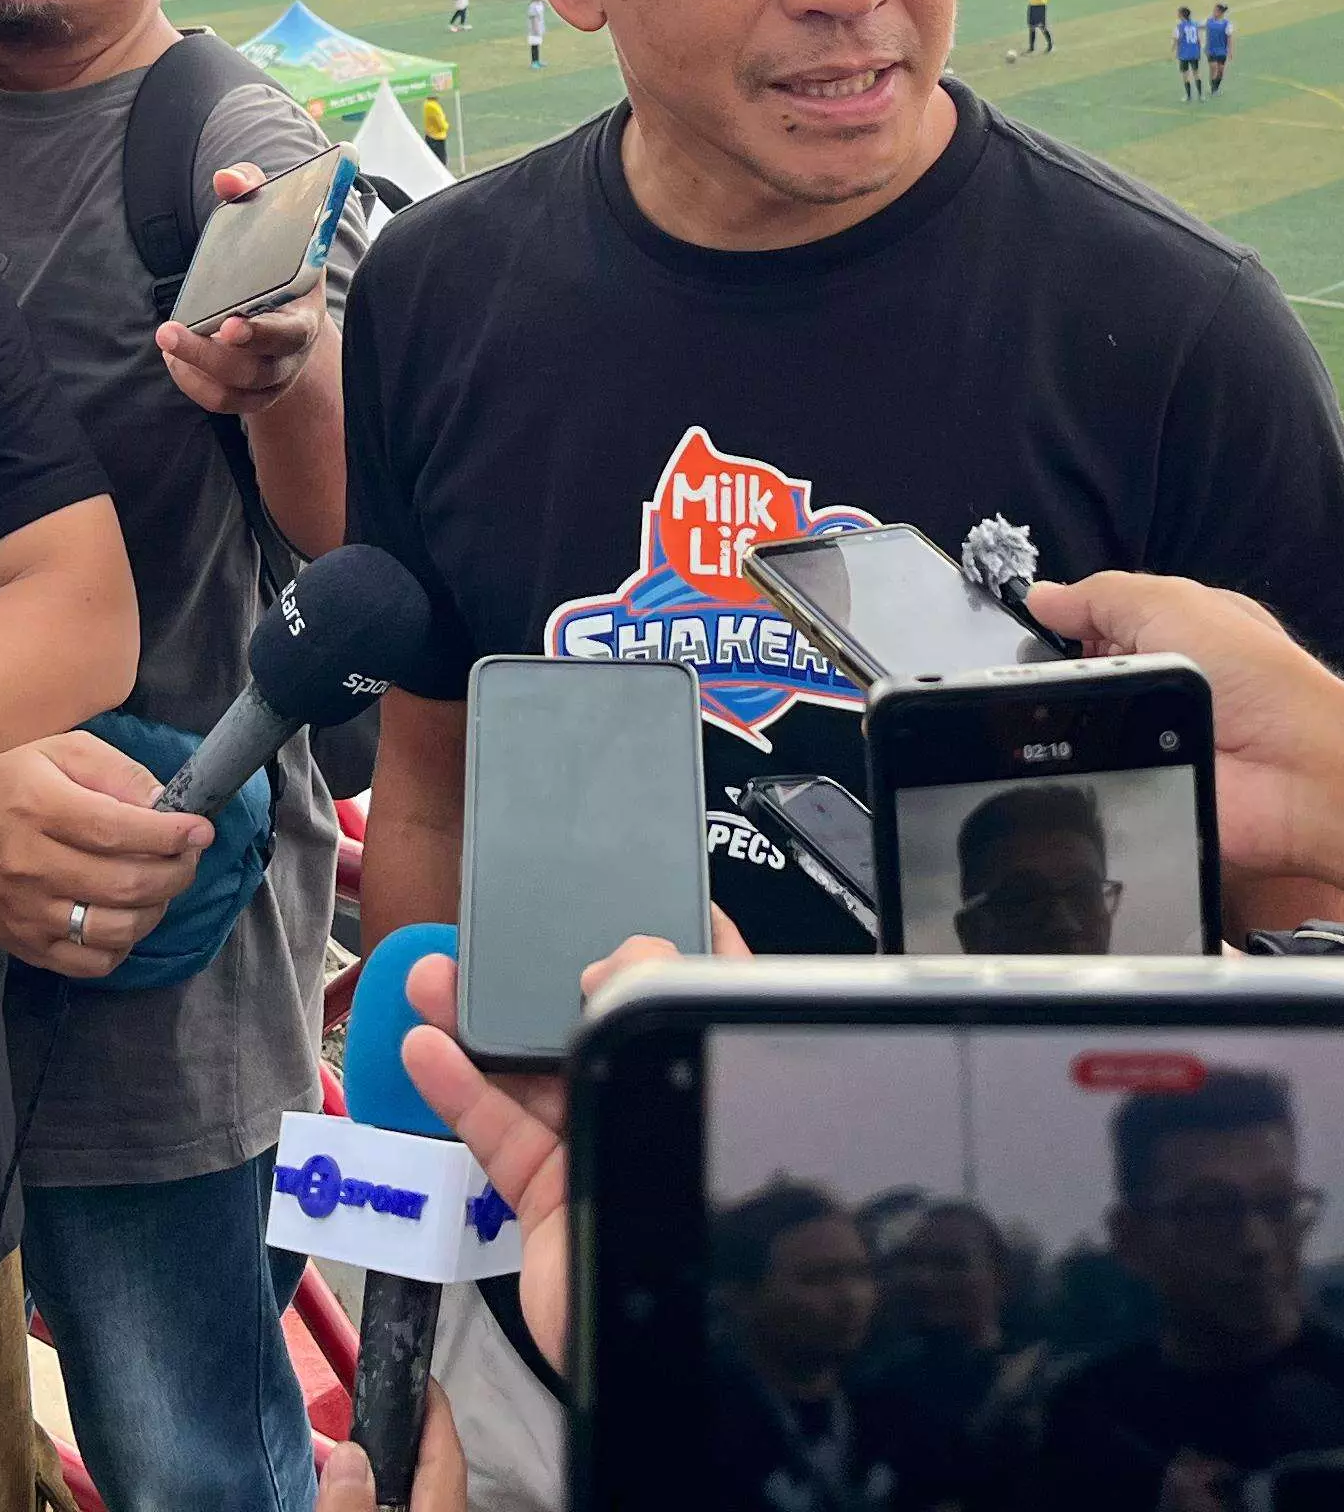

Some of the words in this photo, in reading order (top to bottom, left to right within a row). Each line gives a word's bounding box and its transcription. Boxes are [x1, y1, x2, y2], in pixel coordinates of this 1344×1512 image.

[672, 471, 777, 533] Milk
[690, 525, 758, 580] Lif
[564, 613, 850, 677] SHAKER
[707, 822, 787, 871] PECS
